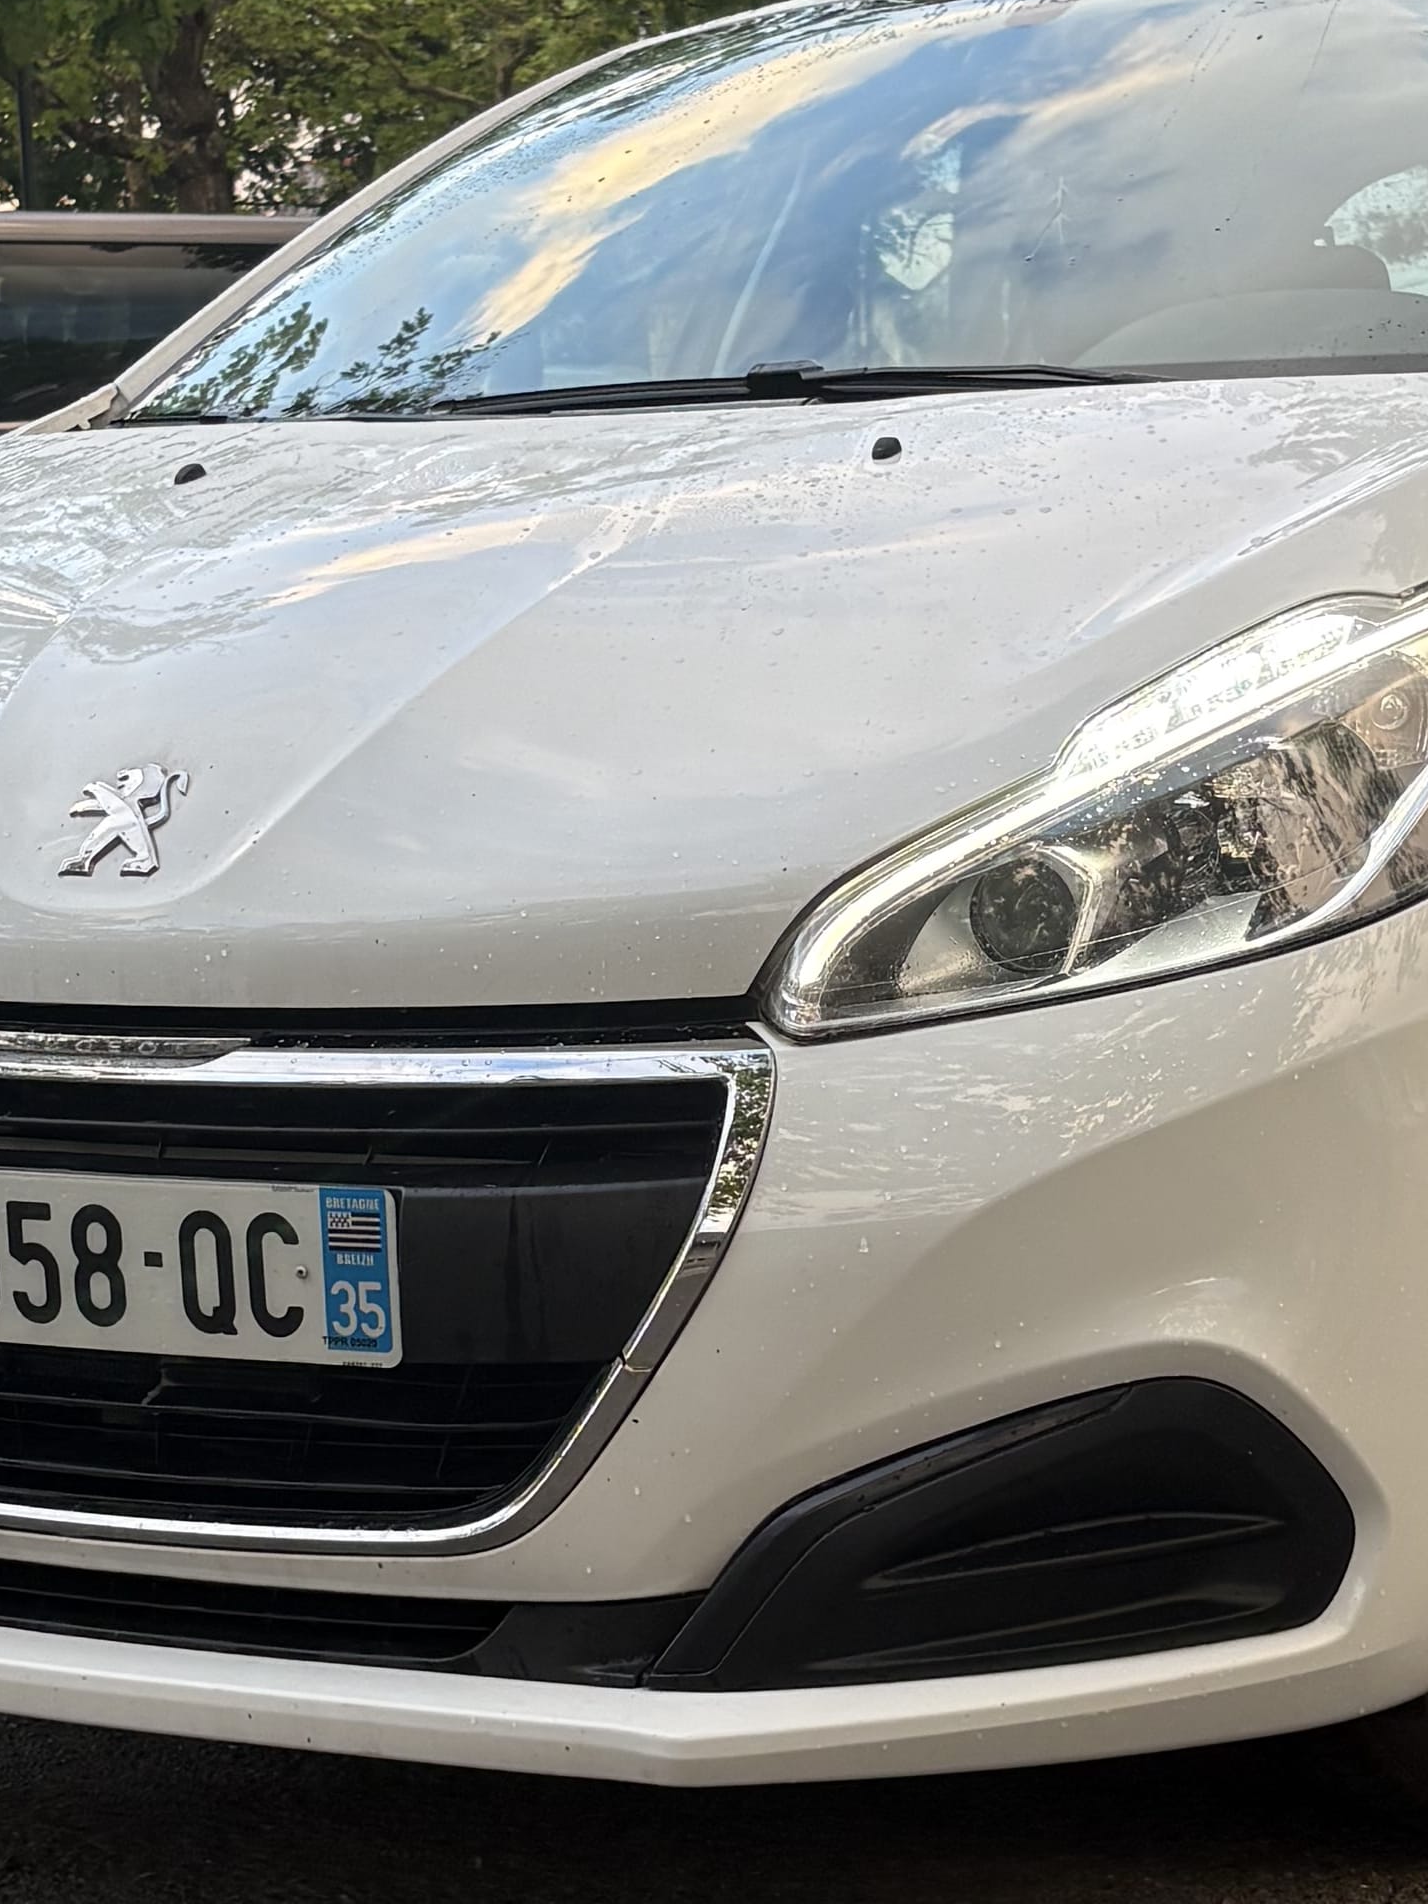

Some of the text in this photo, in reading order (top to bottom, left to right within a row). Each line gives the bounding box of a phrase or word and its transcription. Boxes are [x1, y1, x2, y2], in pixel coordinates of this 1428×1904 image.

[325, 1197, 380, 1211] BRETAGNE
[336, 1253, 375, 1267] BREIZH
[330, 1280, 386, 1339] 35
